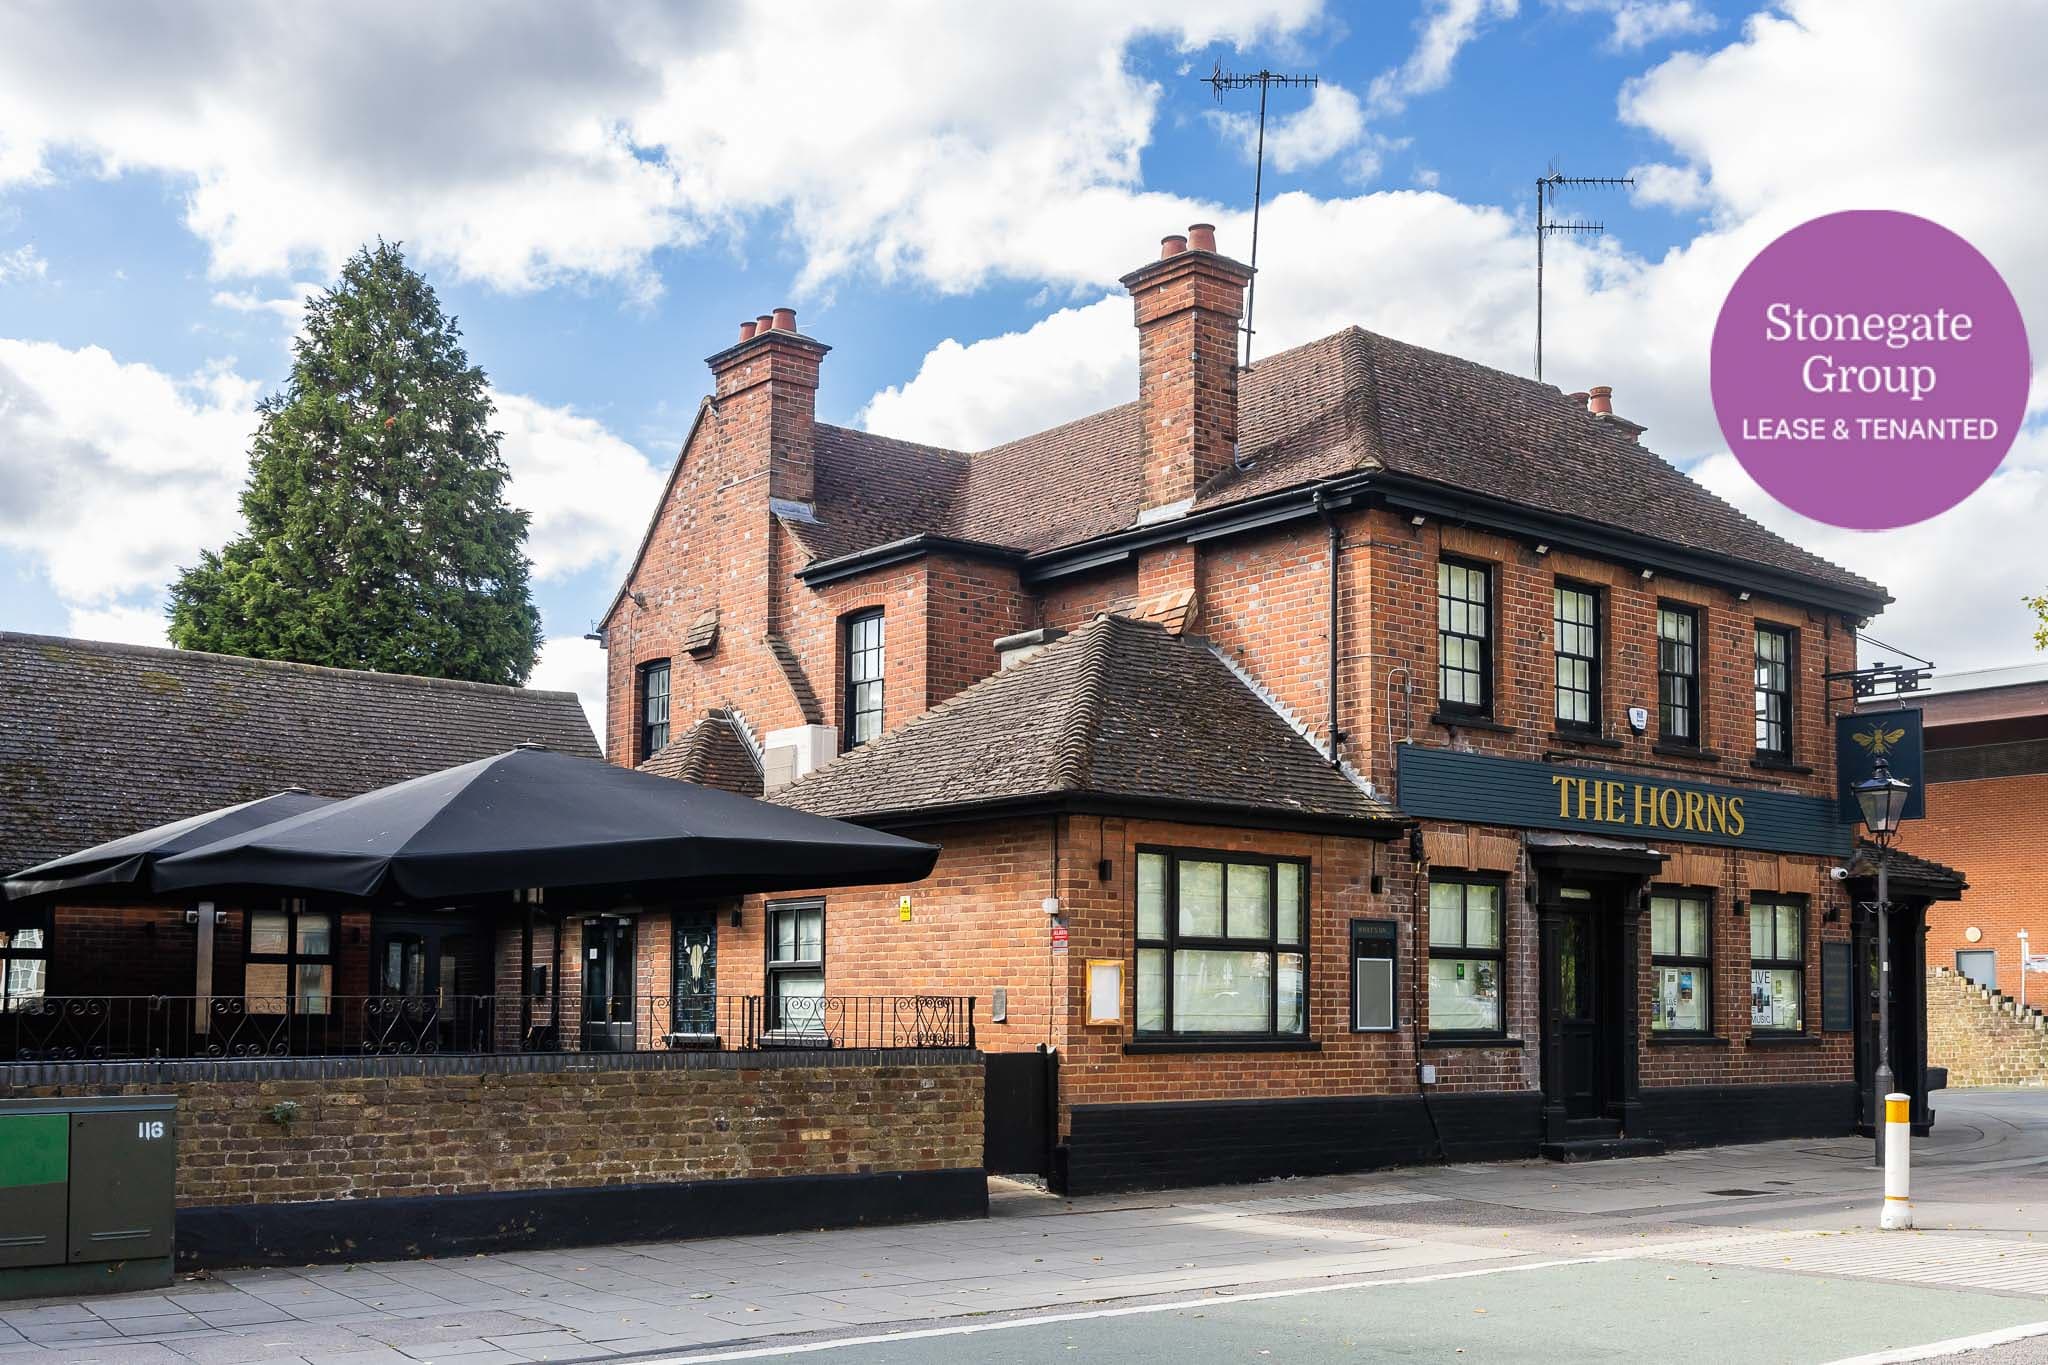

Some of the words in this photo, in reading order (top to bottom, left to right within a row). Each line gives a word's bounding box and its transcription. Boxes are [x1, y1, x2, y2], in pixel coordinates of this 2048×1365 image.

[1552, 775, 1625, 824] THE
[1633, 785, 1745, 836] HORNS
[138, 1121, 164, 1140] 116
